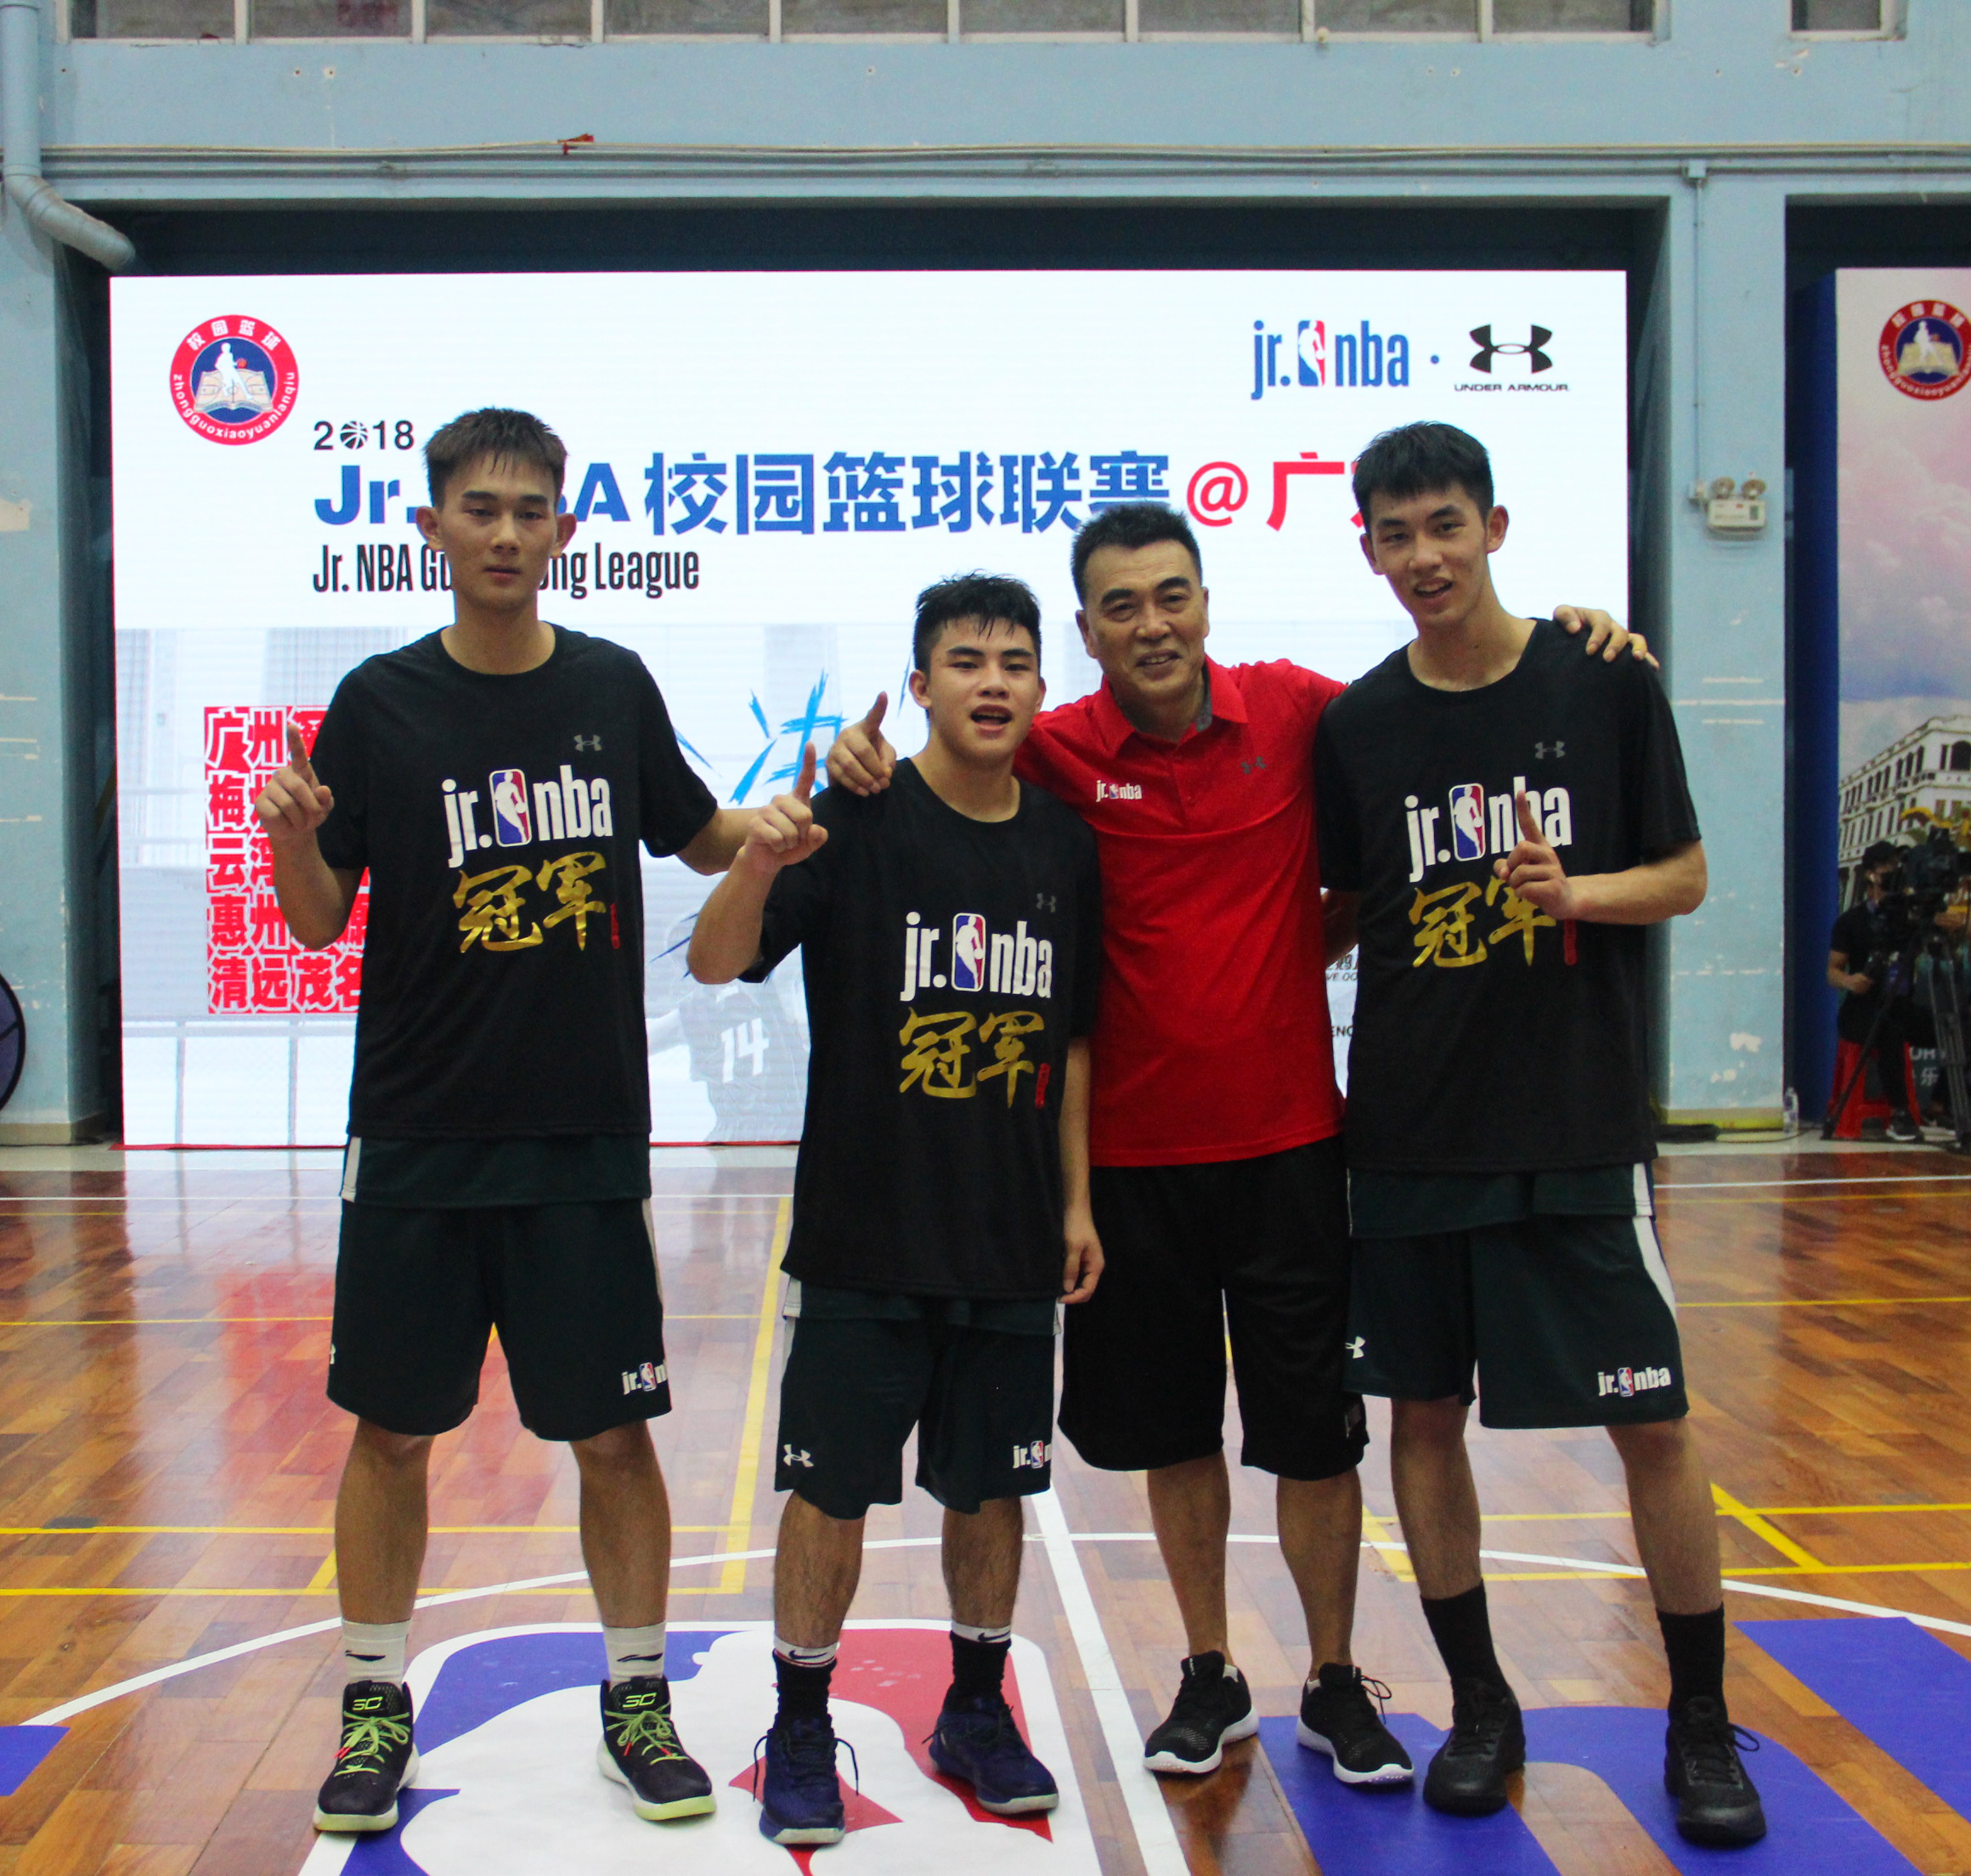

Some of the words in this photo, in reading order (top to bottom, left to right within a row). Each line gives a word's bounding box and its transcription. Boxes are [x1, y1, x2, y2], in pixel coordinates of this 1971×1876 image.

[1335, 319, 1409, 387] nba
[1454, 383, 1503, 393] UNDER
[1506, 383, 1570, 393] ARMOUR
[313, 545, 350, 593] Jr.
[357, 545, 414, 592] NBA
[595, 542, 699, 600] League
[533, 764, 613, 841] nba
[990, 920, 1053, 998] nba
[720, 1019, 770, 1084] 14
